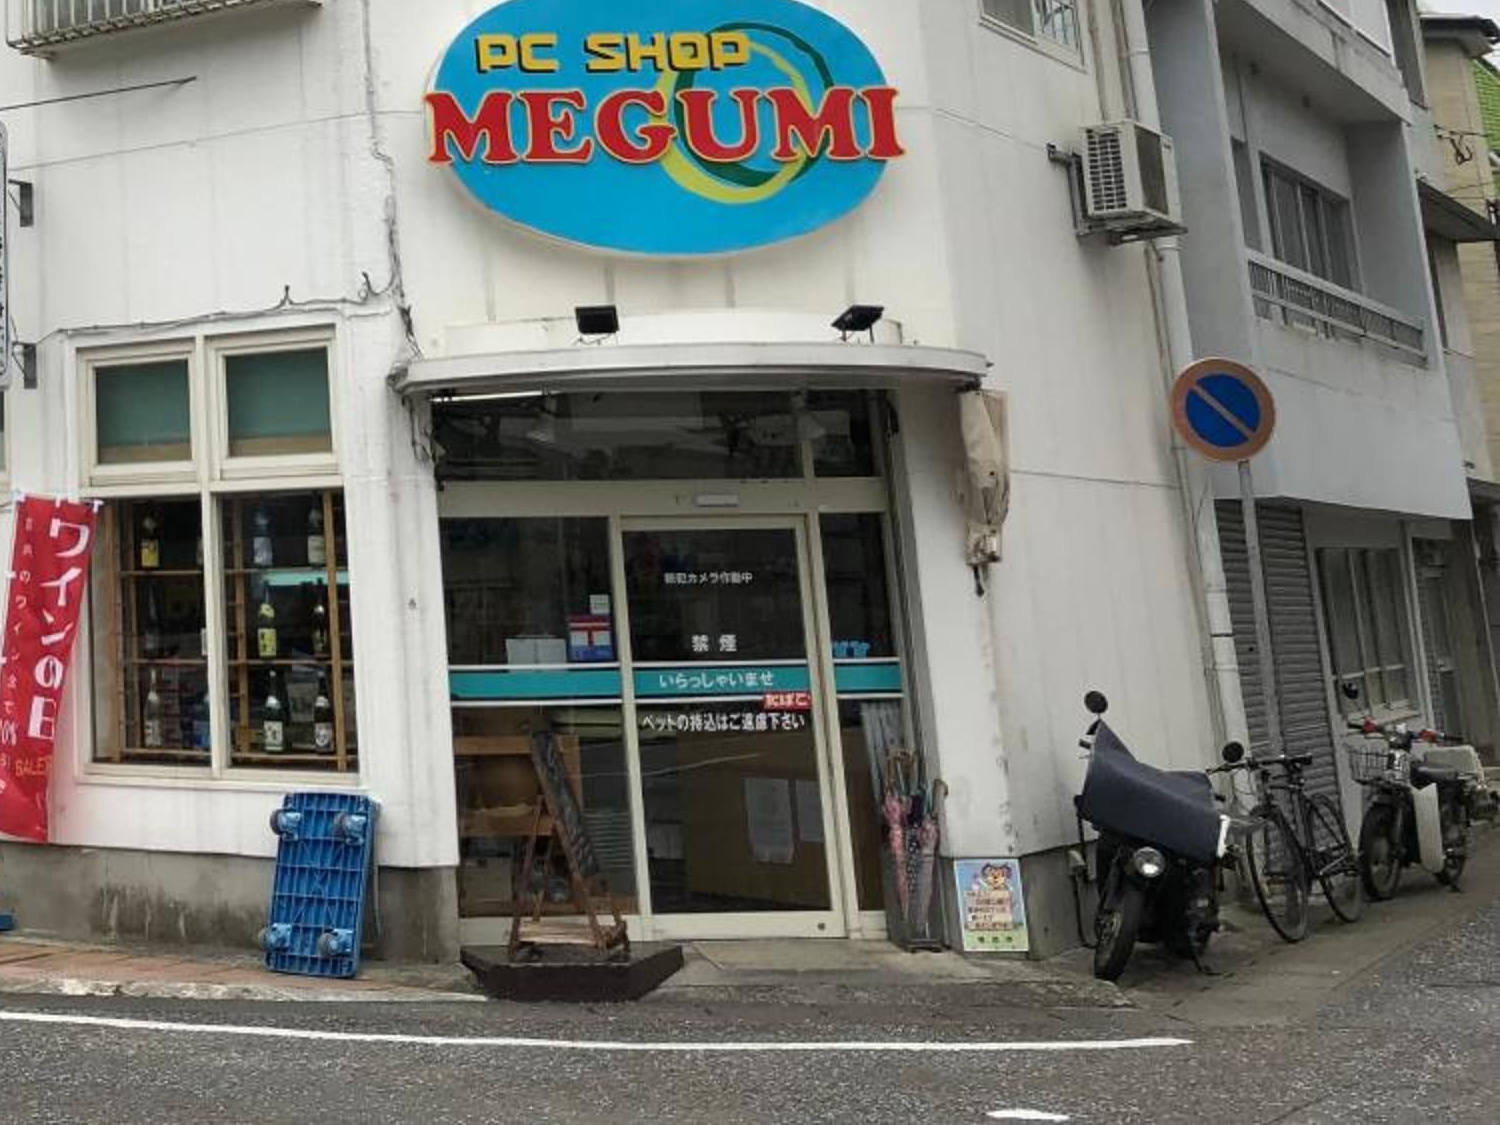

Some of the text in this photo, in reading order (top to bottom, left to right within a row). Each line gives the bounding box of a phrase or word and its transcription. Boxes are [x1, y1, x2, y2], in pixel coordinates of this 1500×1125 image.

[475, 32, 750, 73] PC SHOP
[424, 87, 905, 164] MEGUMI
[27, 518, 90, 740] ワインの日
[691, 634, 738, 652] 禁煙
[659, 671, 774, 689] いらっしゃいませ
[642, 711, 805, 732] ペットの持込はご遠慮下さい
